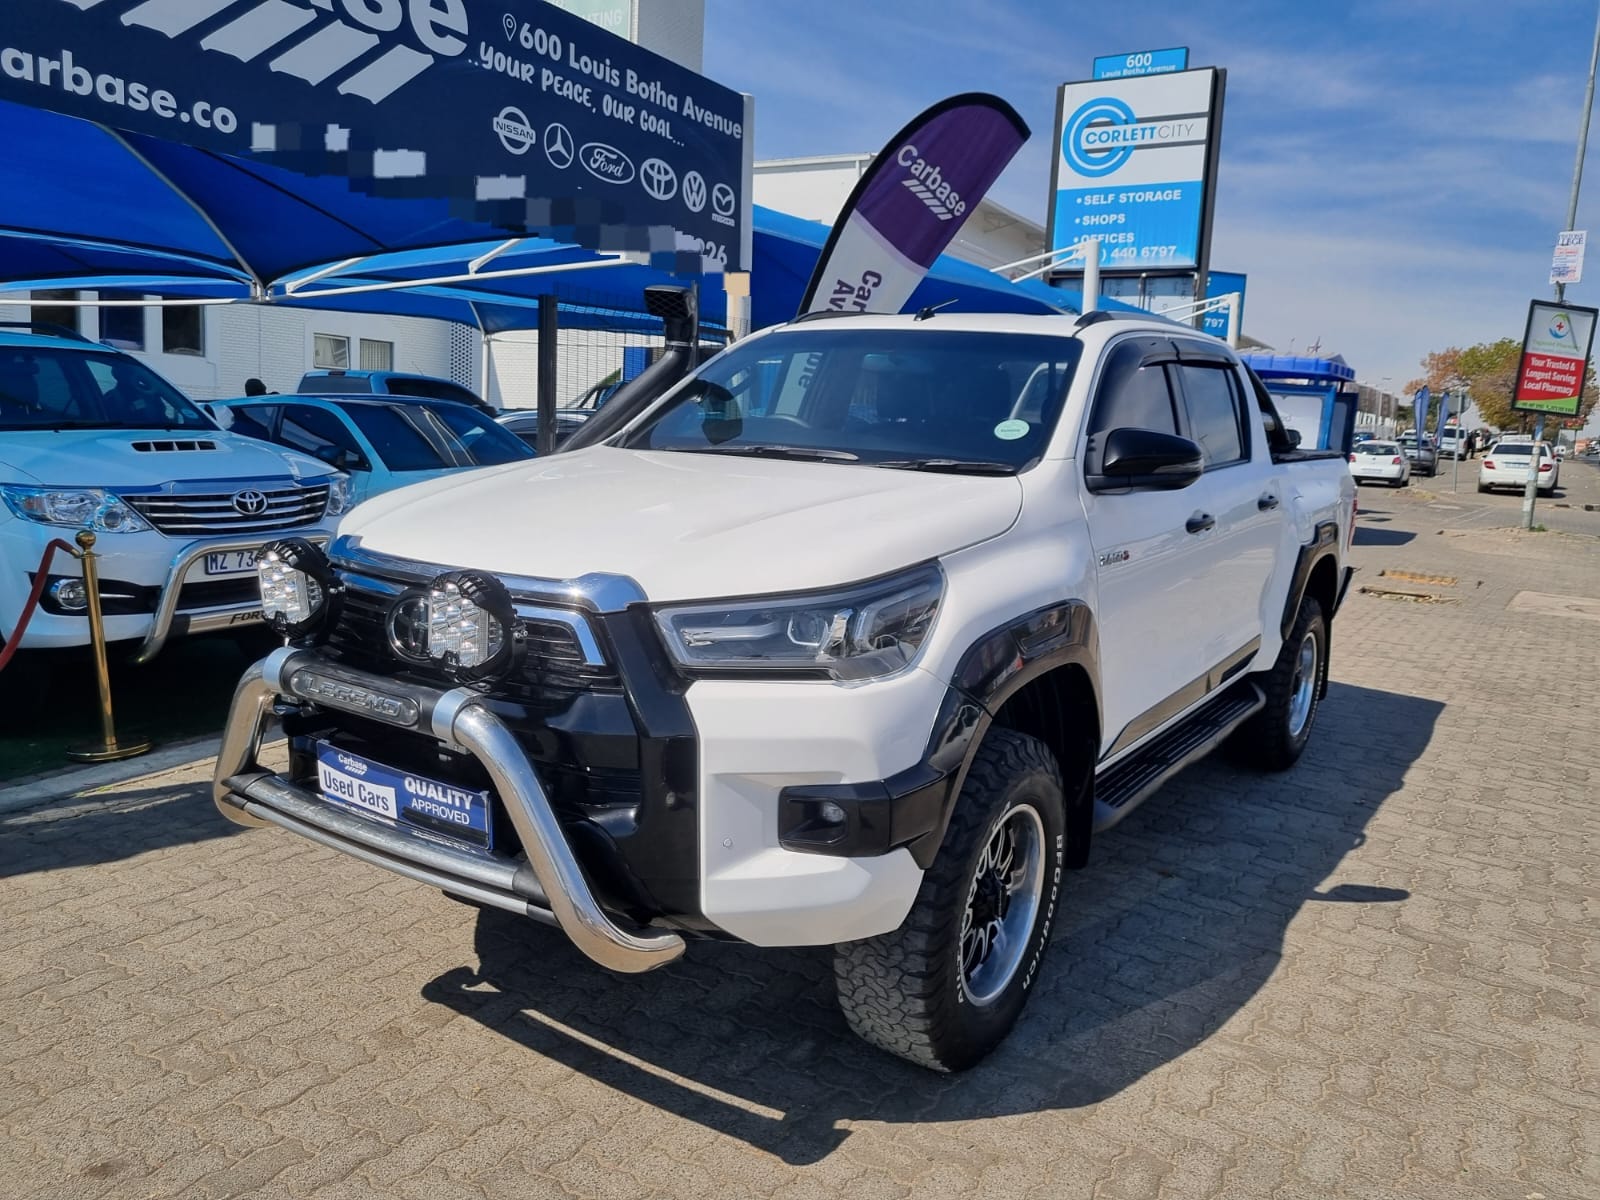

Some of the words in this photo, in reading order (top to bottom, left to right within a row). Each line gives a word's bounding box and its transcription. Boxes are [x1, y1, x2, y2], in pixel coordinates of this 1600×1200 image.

[1126, 52, 1153, 68] 600
[1101, 70, 1121, 79] Louis
[1123, 66, 1145, 76] Botha
[1146, 64, 1177, 73] Avenue
[519, 22, 562, 61] 600
[569, 42, 620, 88] Louis
[626, 68, 678, 112] Botha
[682, 95, 743, 140] Avenue
[602, 93, 635, 126] OUR
[496, 120, 534, 141] NISSAN
[590, 148, 626, 177] Ford
[897, 144, 966, 217] Carbase
[1083, 193, 1115, 206] SELF
[1119, 189, 1182, 204] STORAGE
[1082, 213, 1126, 226] SHOPS
[1111, 247, 1137, 258] 440
[1141, 246, 1177, 257] 6797
[1531, 357, 1546, 367] Your
[1546, 359, 1570, 370] Trusted
[1525, 368, 1551, 380] Longest
[1553, 371, 1576, 385] Serving
[1524, 380, 1541, 390] Local
[1542, 382, 1574, 396] Pharmacy
[209, 553, 228, 571] MZ
[337, 753, 368, 772] Carbase
[323, 769, 355, 799] Used
[358, 783, 390, 812] Cars
[404, 776, 474, 810] QUALITY
[411, 797, 470, 825] APPROVED
